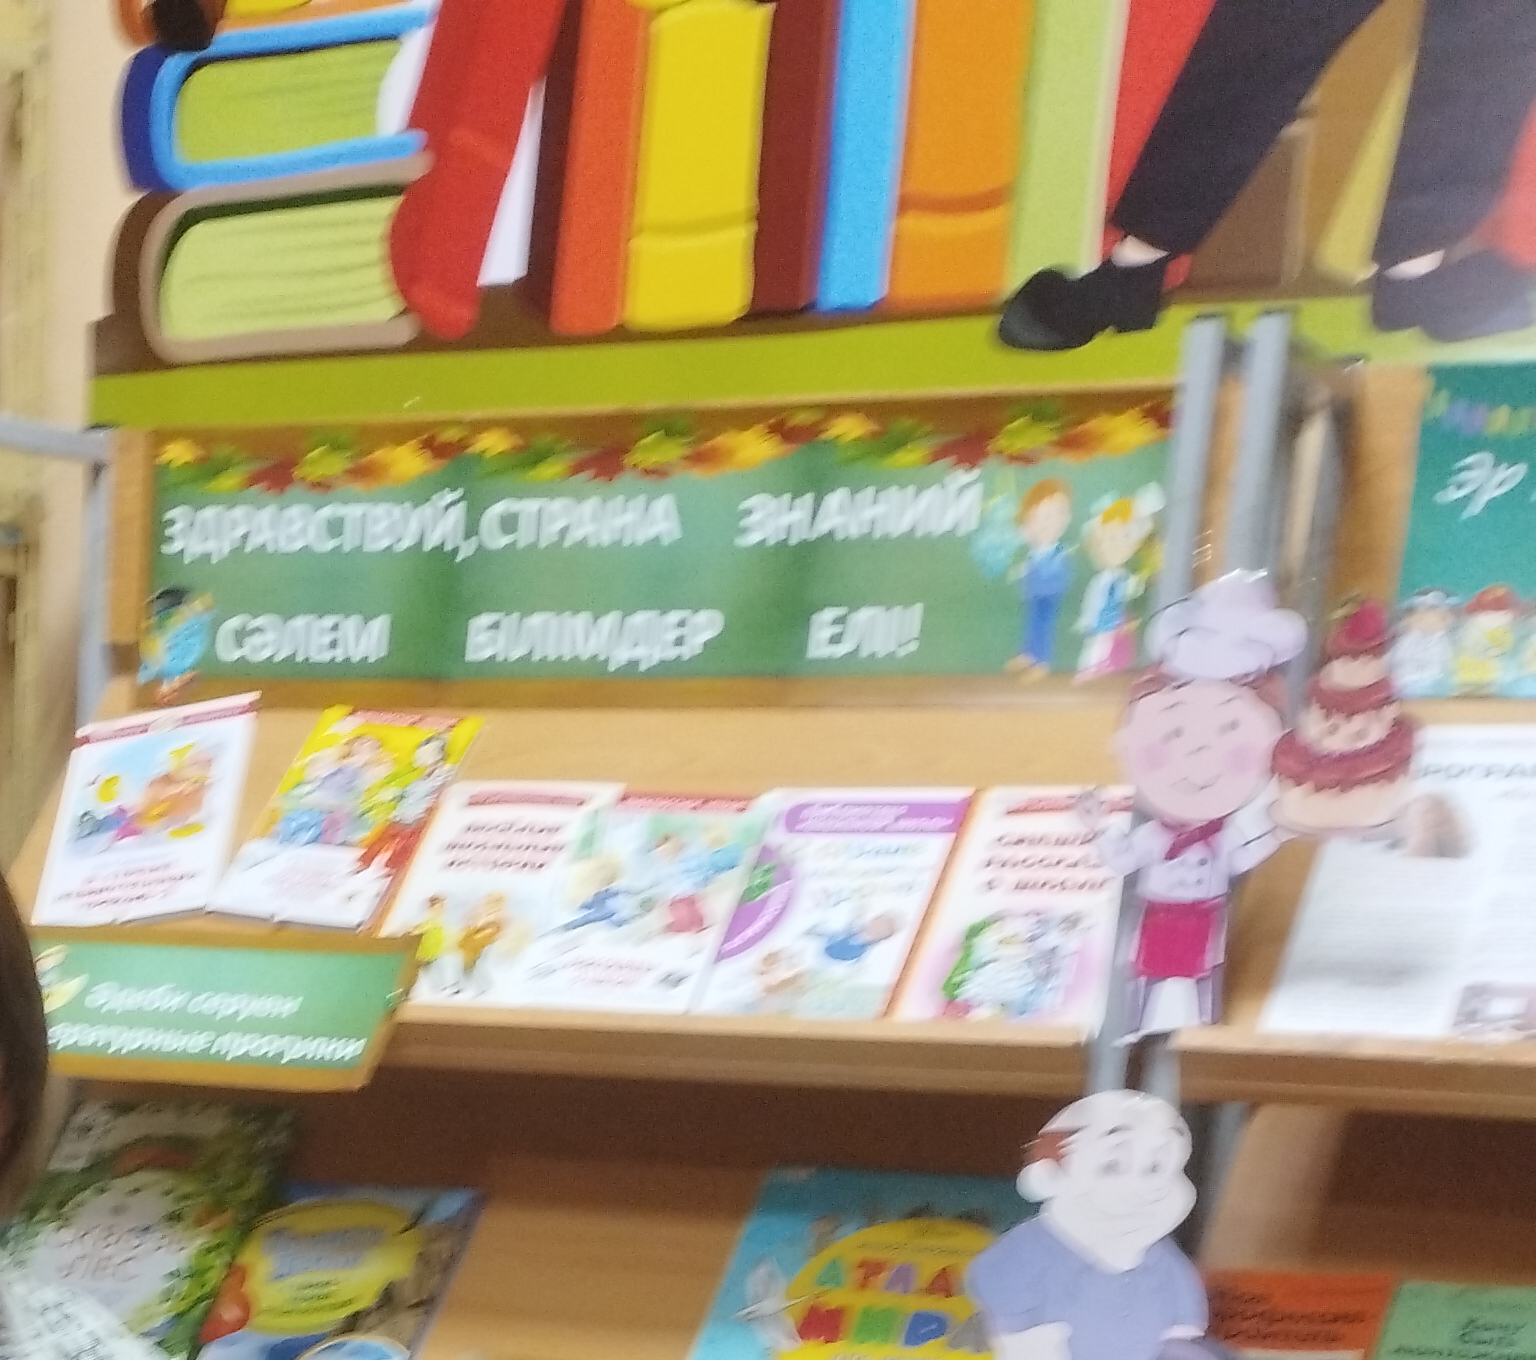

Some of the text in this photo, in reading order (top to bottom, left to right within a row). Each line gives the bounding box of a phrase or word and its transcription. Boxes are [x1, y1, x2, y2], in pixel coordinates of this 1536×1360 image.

[734, 470, 985, 548] ЗНАНИЙ
[215, 612, 392, 663] СӘЛЕМ
[465, 608, 724, 672] БІЛІМДЕР
